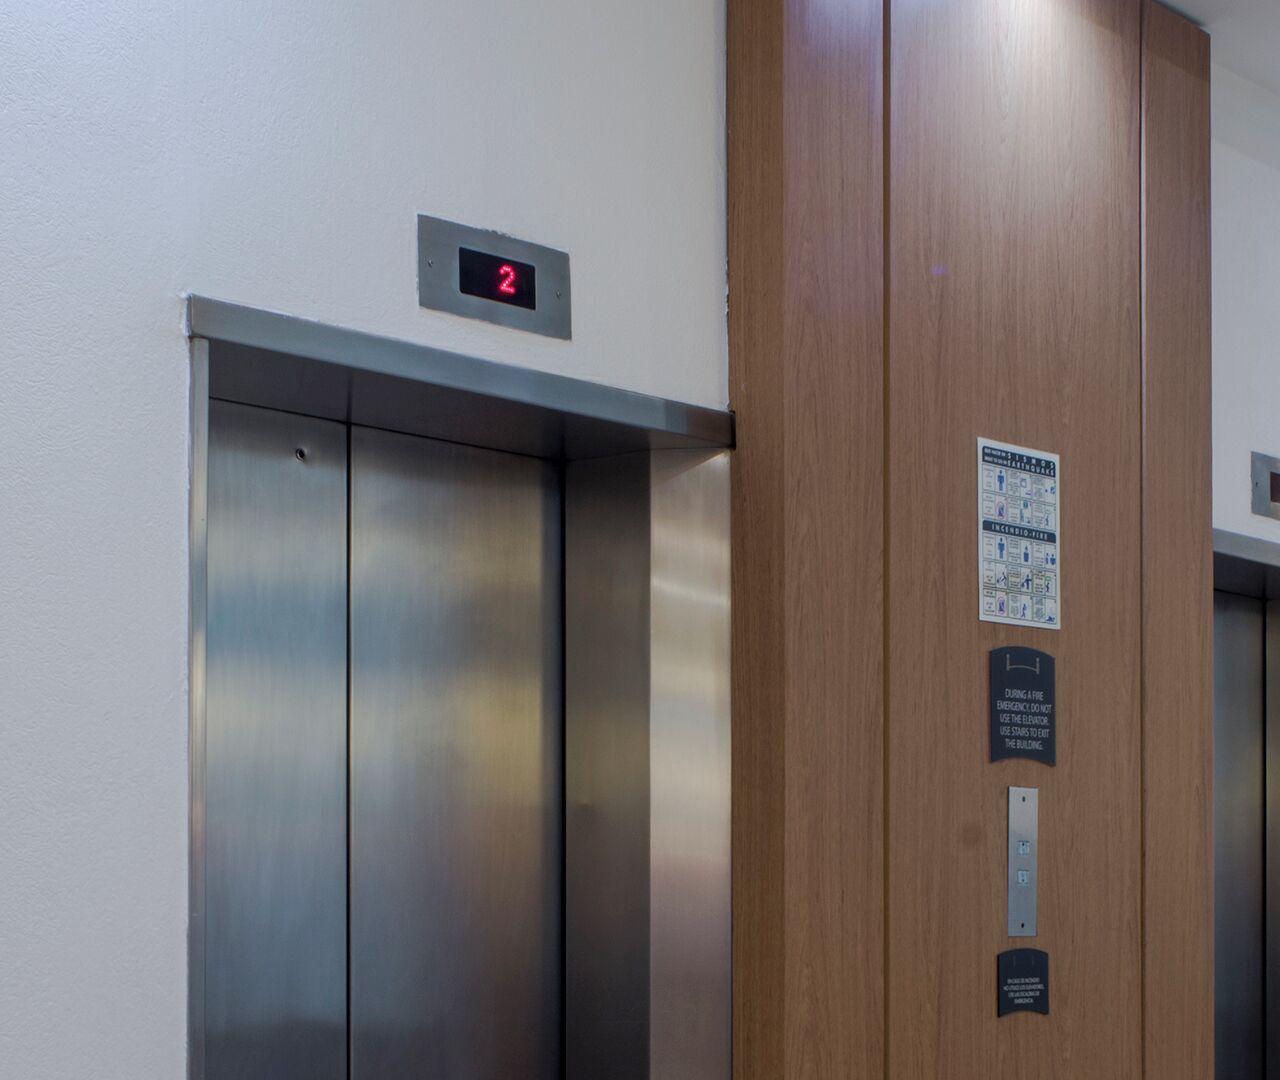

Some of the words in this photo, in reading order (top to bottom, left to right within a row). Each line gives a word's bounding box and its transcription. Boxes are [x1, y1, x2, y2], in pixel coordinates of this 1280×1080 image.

[499, 265, 516, 294] 2
[1007, 460, 1054, 476] EARTHQUAKE
[1005, 688, 1026, 699] DURING
[1027, 690, 1032, 700] A
[1032, 691, 1044, 701] FIRE
[1031, 703, 1040, 713] DO
[1040, 704, 1052, 714] NOT
[1000, 713, 1010, 723] USE
[1011, 714, 1022, 724] THE
[1000, 726, 1011, 736] USE
[1011, 726, 1030, 737] STAIRS
[1030, 727, 1038, 738] TO
[1038, 728, 1050, 738] EXIT
[1005, 738, 1016, 749] THE
